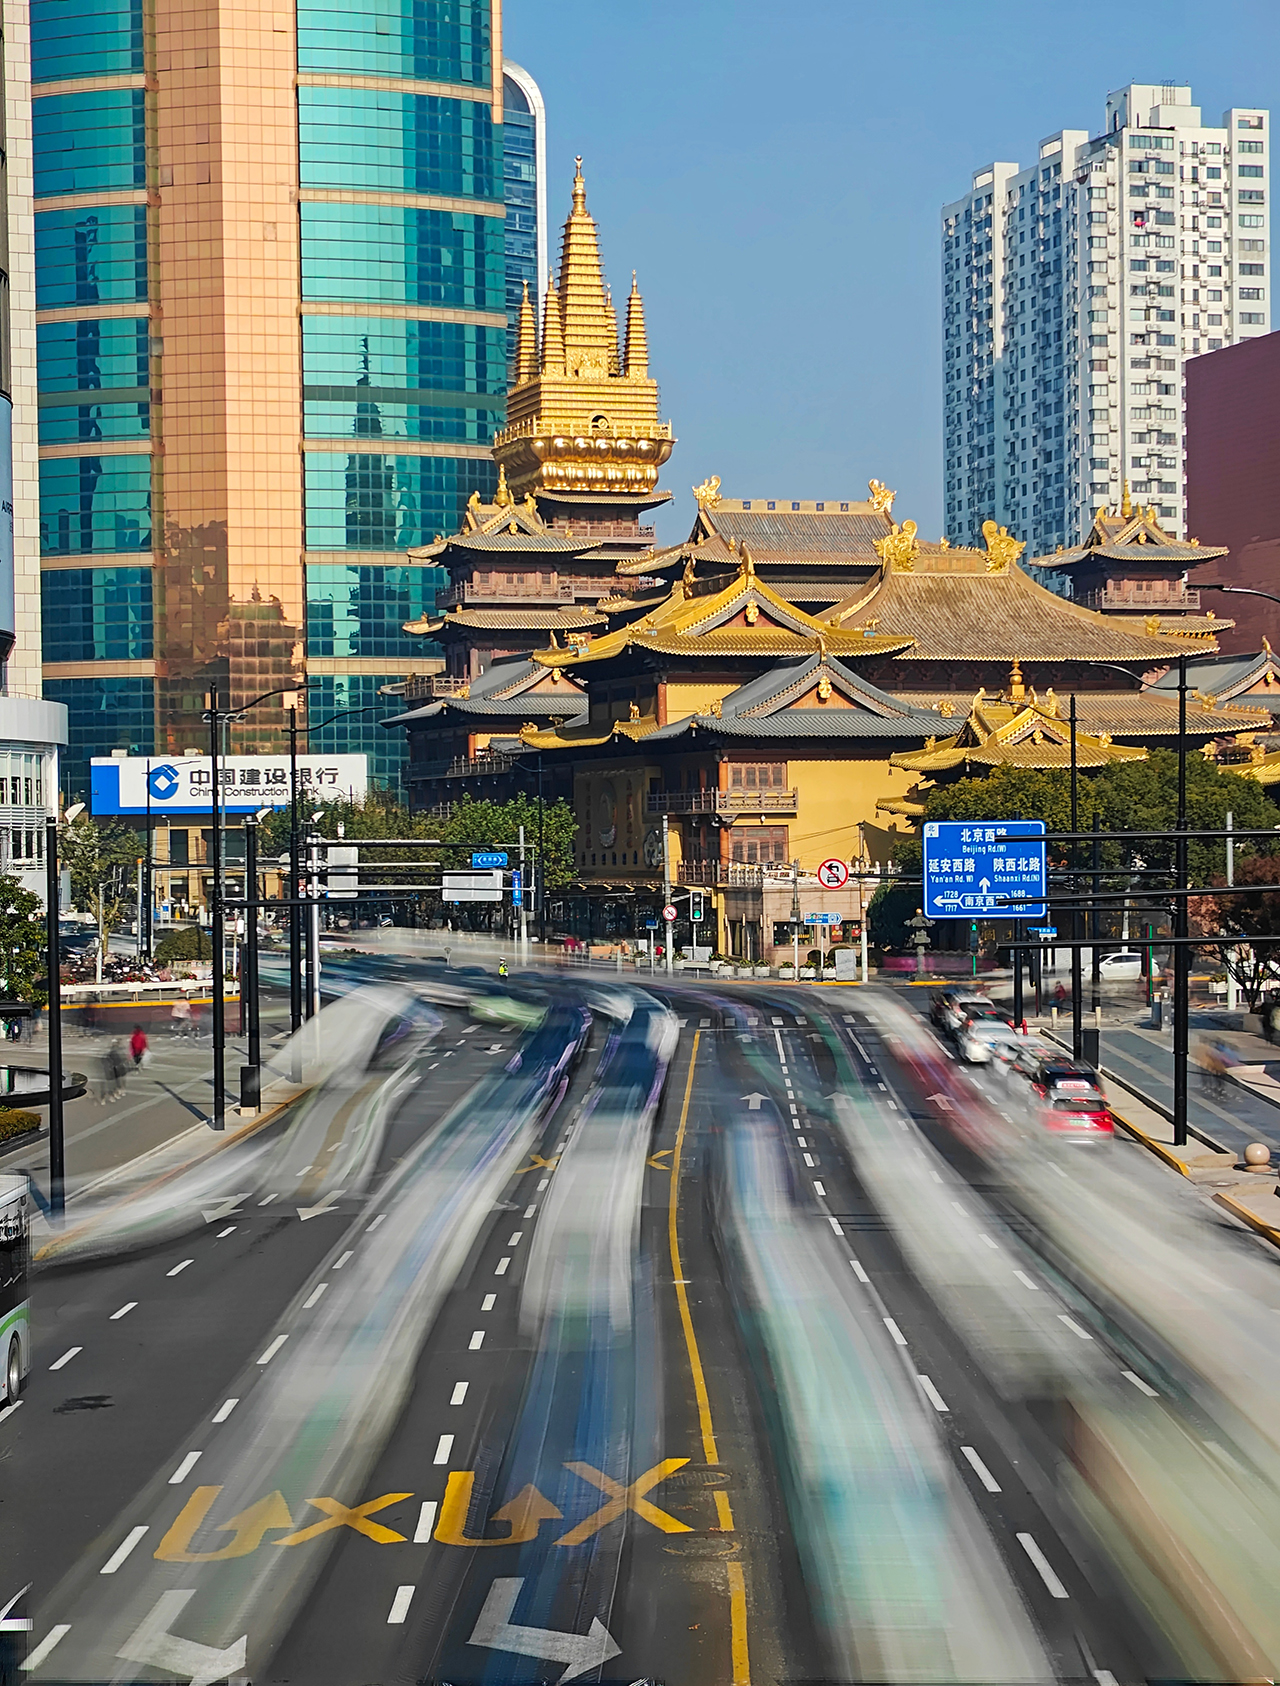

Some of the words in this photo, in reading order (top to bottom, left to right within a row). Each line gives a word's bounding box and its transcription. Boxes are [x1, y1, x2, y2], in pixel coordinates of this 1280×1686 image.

[190, 767, 338, 785] 中国建设银行
[189, 787, 220, 797] Chin
[224, 787, 288, 797] Construction
[962, 845, 986, 855] Beijing
[928, 858, 975, 873] 延安西路
[993, 857, 1040, 872] 陕西北路
[930, 875, 953, 883] Yan'an
[994, 874, 1020, 882] Shaanxi
[1011, 889, 1026, 898] 1688
[945, 904, 957, 912] 1717
[1012, 904, 1026, 912] 1661
